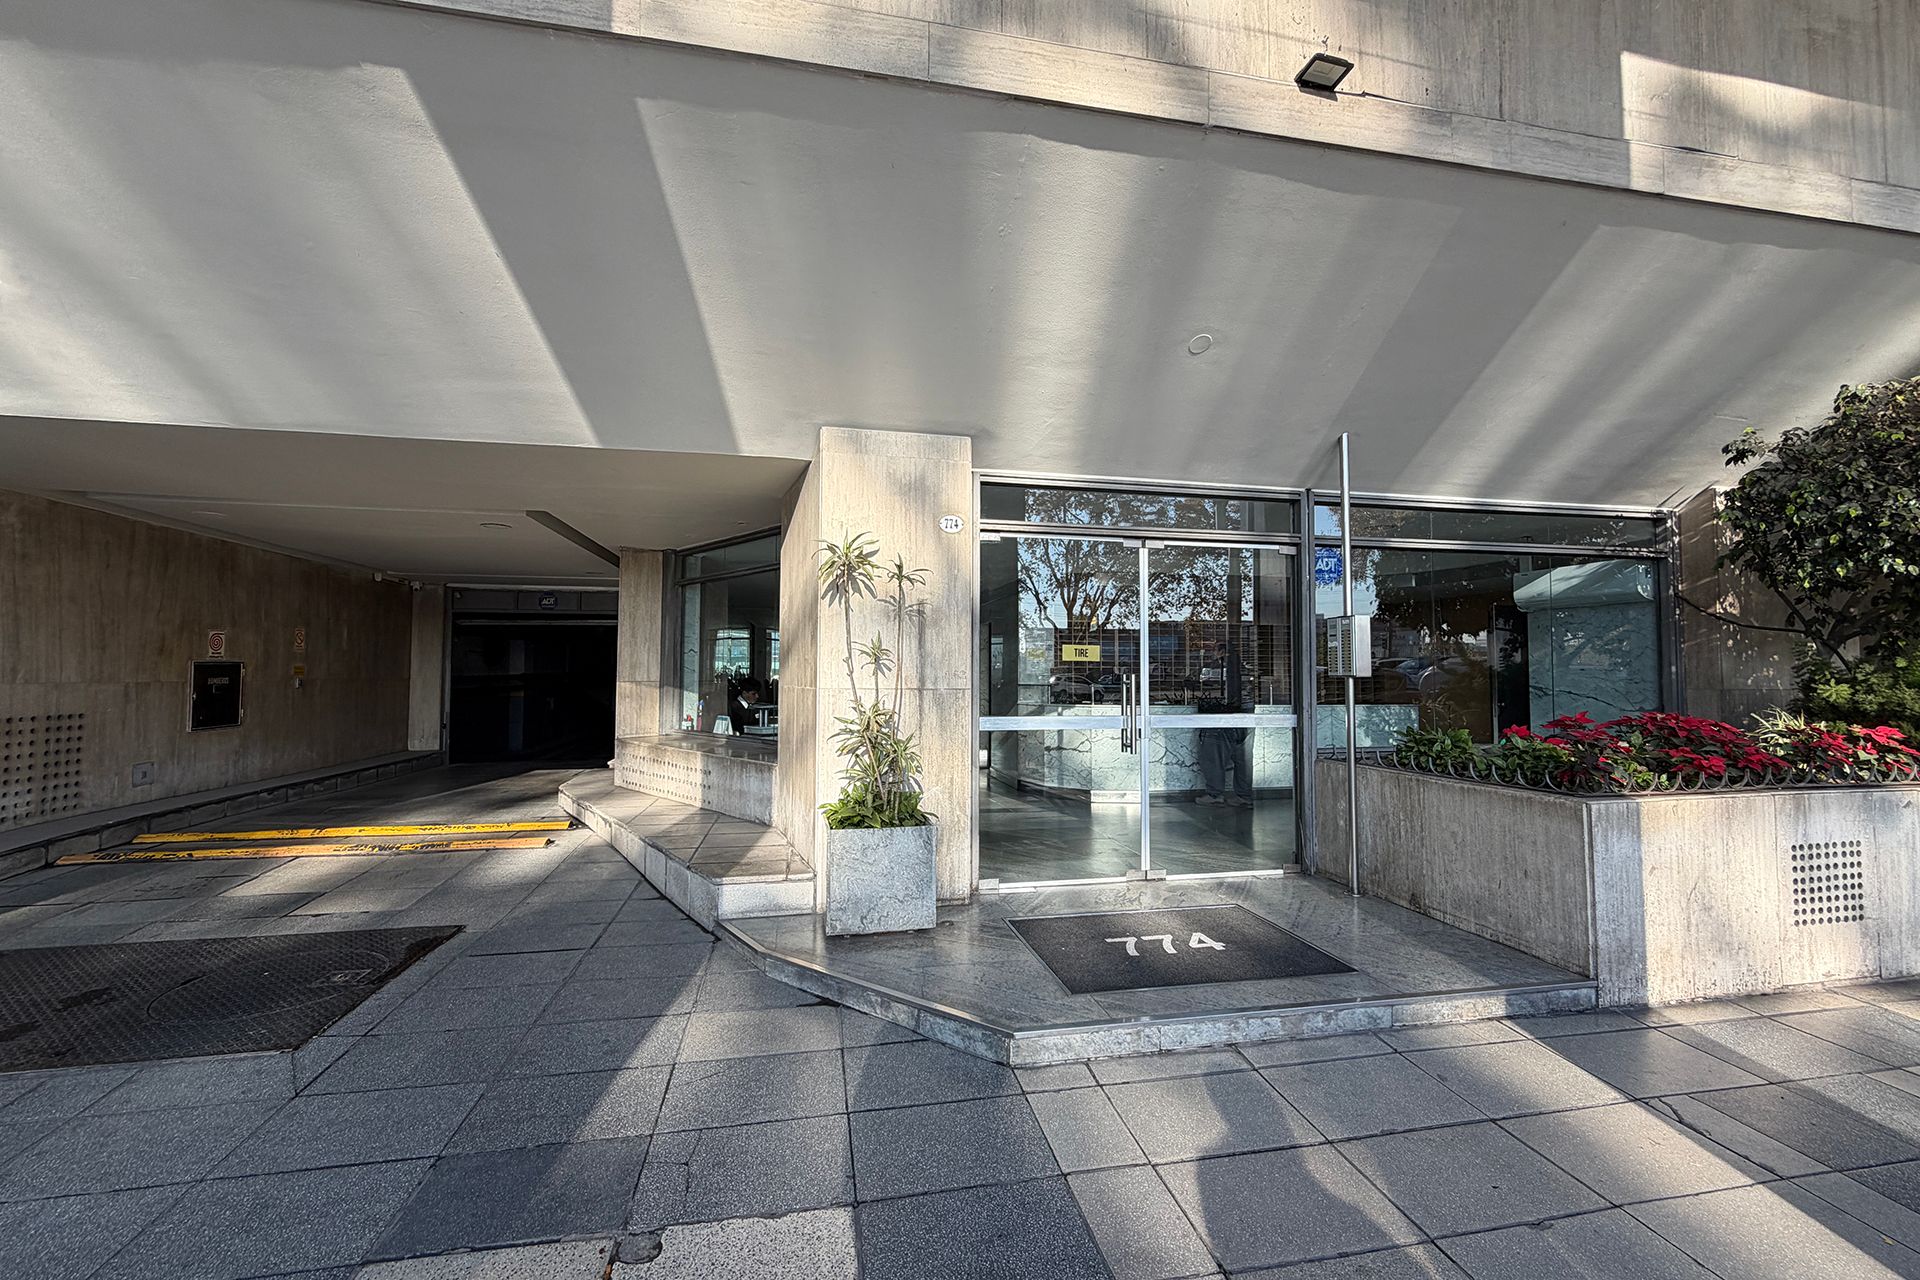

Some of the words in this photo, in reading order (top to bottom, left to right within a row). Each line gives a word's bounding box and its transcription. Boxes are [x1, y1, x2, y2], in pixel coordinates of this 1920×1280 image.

[944, 518, 959, 529] 774
[1315, 558, 1338, 572] ADT
[1074, 648, 1089, 658] TIRE
[1104, 932, 1226, 956] 774
